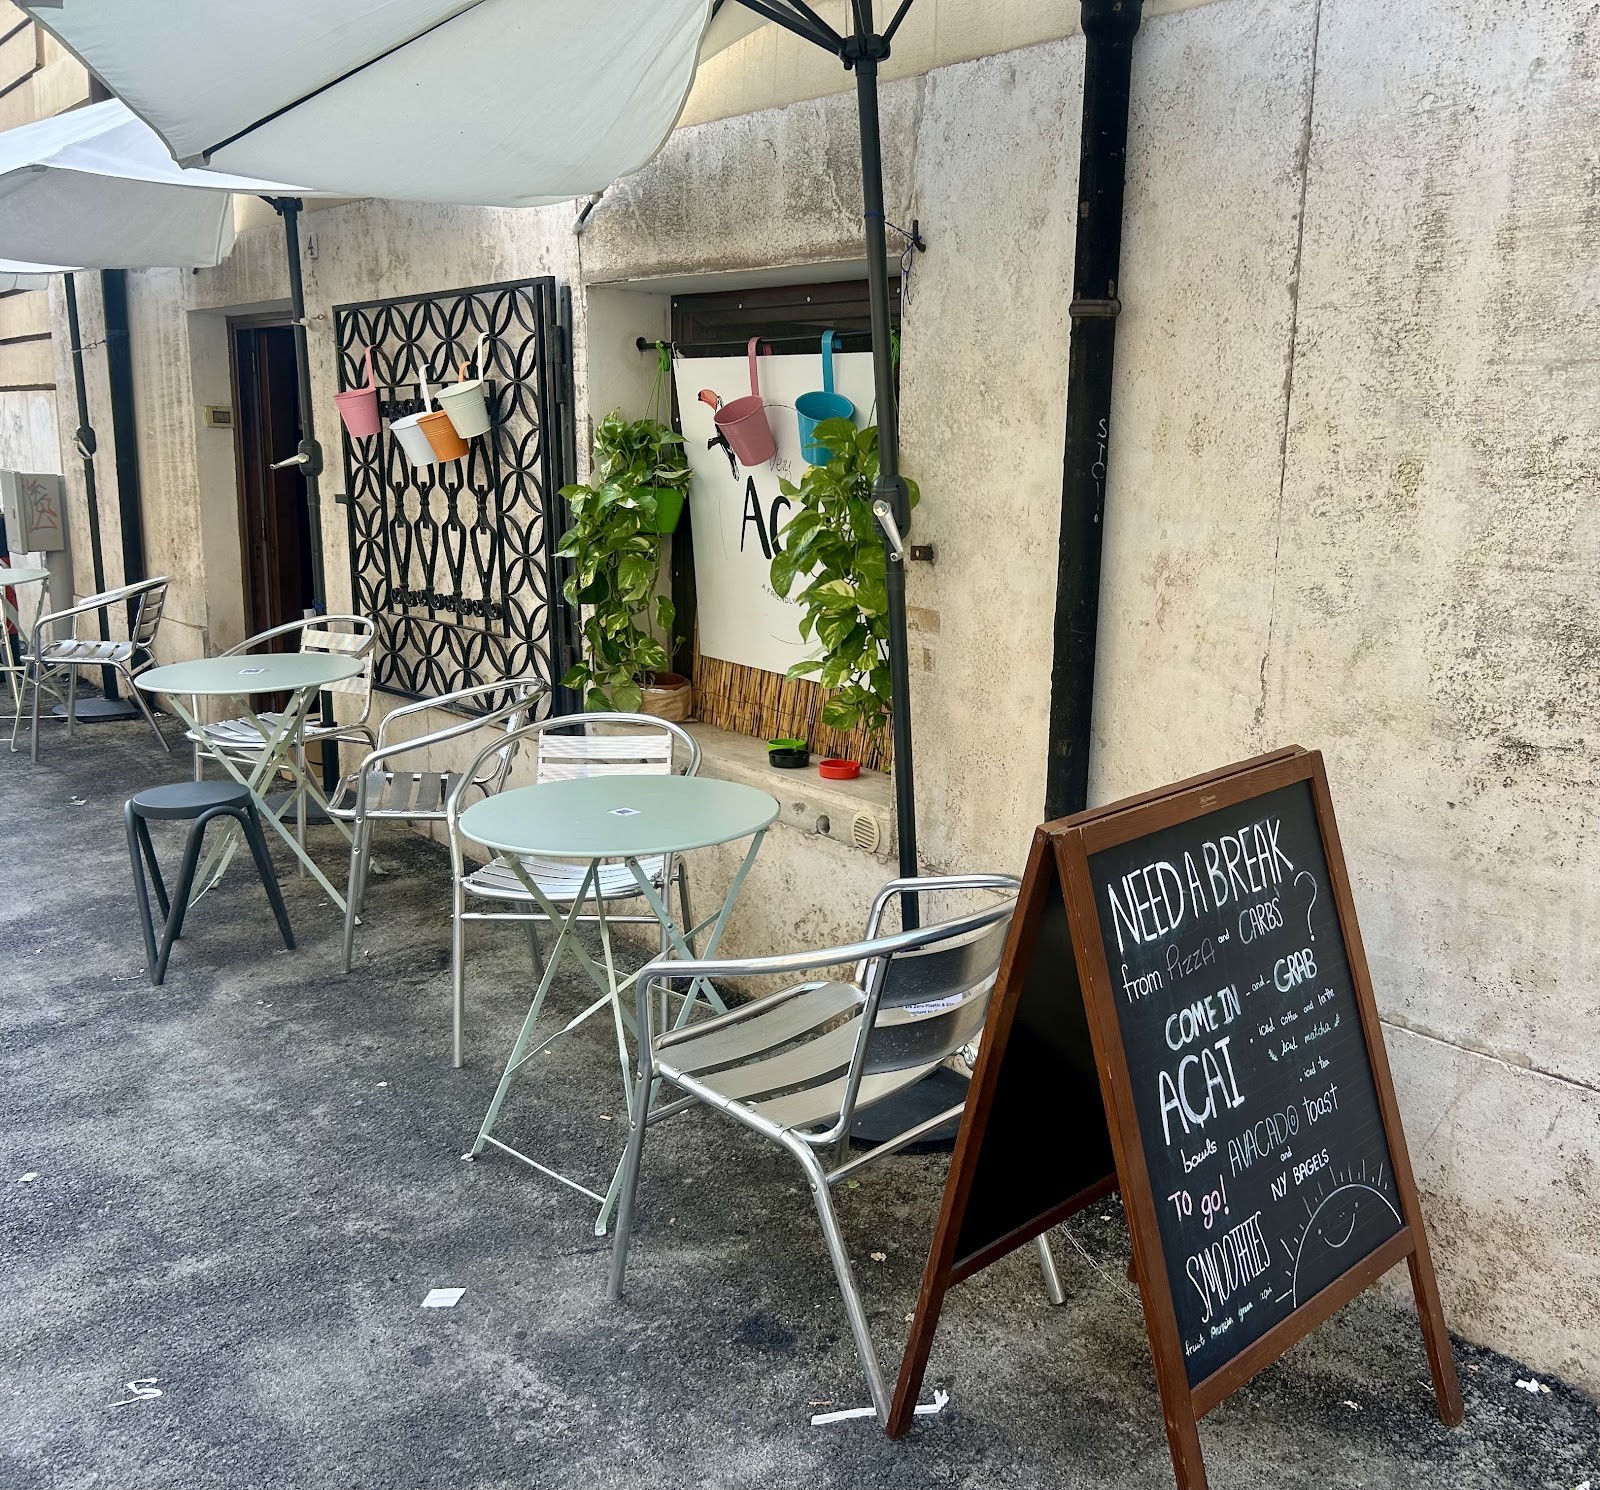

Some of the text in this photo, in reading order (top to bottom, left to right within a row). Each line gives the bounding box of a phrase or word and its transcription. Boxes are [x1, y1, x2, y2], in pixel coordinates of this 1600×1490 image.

[1107, 818, 1294, 954] NEED A BREAK
[1122, 963, 1164, 1004] from
[1217, 931, 1231, 945] and
[1238, 896, 1284, 945] CARBS
[1164, 994, 1220, 1051] COME
[1216, 983, 1242, 1025] IN
[1273, 948, 1318, 993] GRAB
[1257, 987, 1335, 1037] iced coffee and latte
[1304, 1020, 1332, 1044] matcha
[1303, 1055, 1331, 1078] iced tea
[1180, 1138, 1218, 1174] bowls
[1227, 1083, 1339, 1178] AVACADO toast
[1279, 1145, 1293, 1162] and
[1200, 1174, 1230, 1230] go!
[1270, 1148, 1331, 1202] NY BAGELS
[1185, 1210, 1271, 1324] SMOOTHIES
[1185, 1332, 1206, 1357] fruit
